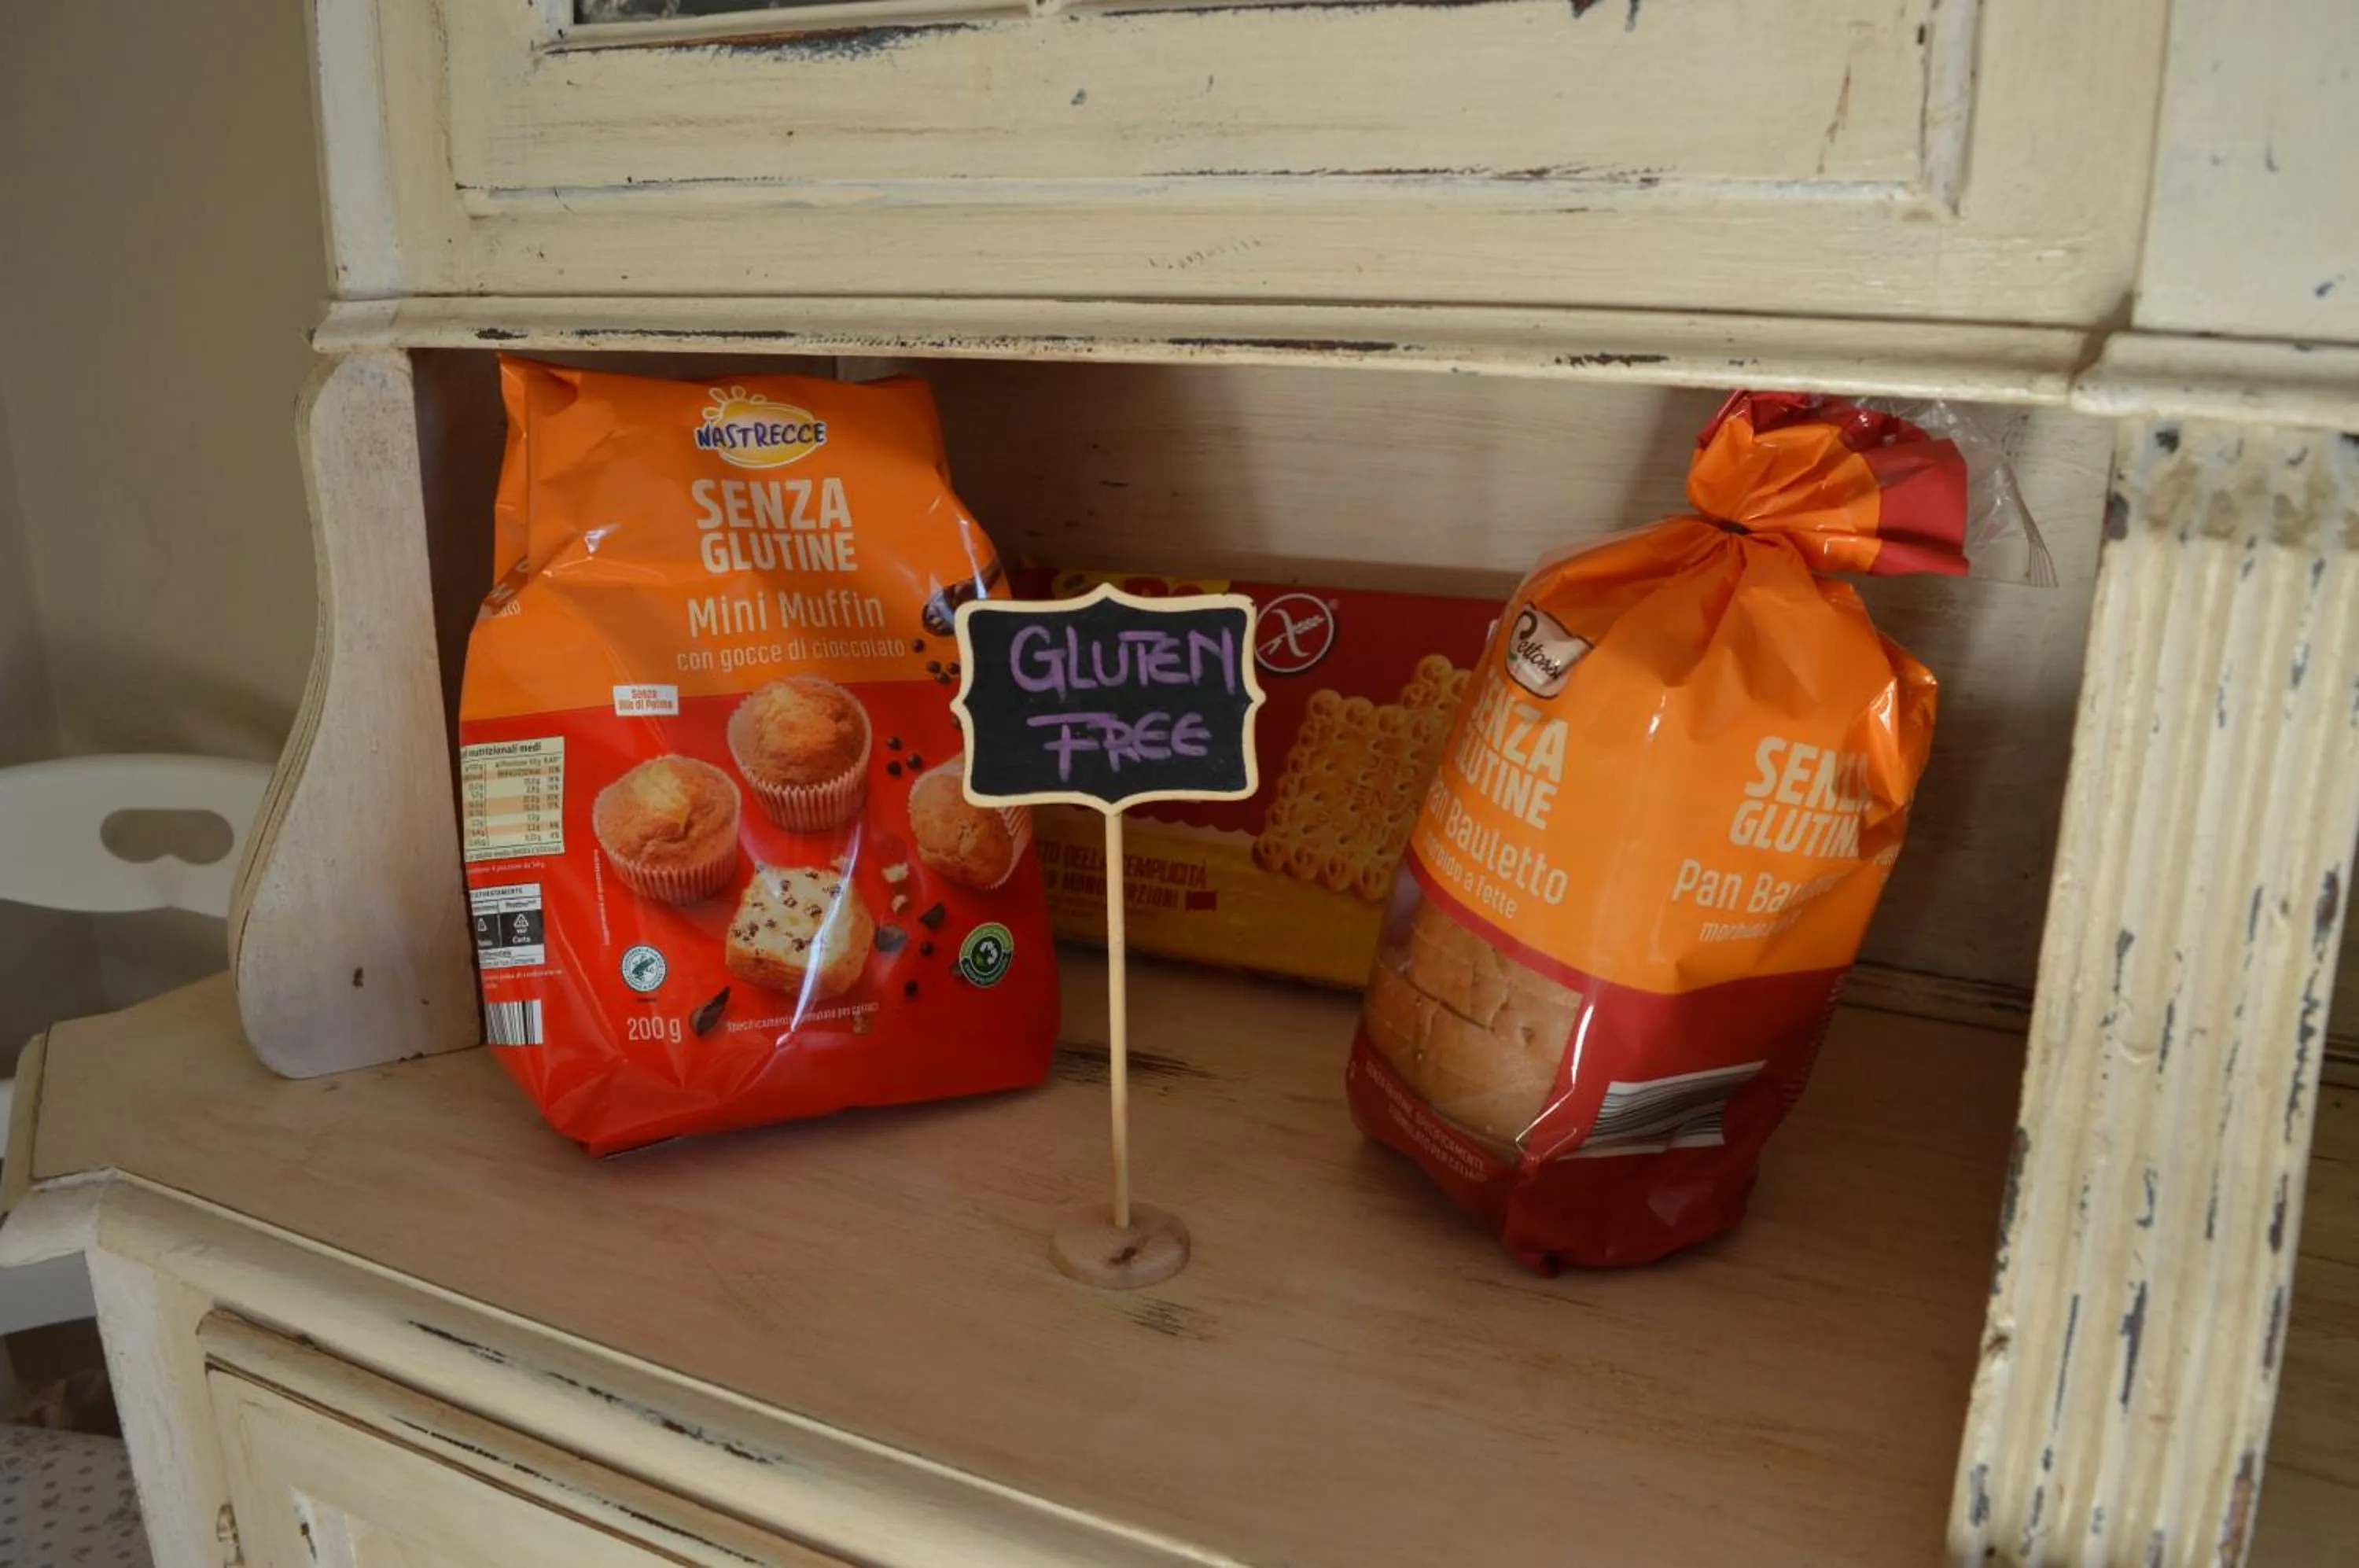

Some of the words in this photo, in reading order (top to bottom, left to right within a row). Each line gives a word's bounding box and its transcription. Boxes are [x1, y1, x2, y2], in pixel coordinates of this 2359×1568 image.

[697, 422, 826, 448] NASTRECCE
[691, 477, 853, 530] SENZA
[701, 532, 858, 574] GLUTINE
[686, 591, 767, 638] Mini
[778, 588, 885, 628] Muffin
[676, 651, 714, 671] con
[719, 643, 783, 673] gocce
[789, 636, 807, 661] di
[811, 637, 906, 659] cioccolato
[1010, 624, 1236, 701] GLUTEN
[1026, 711, 1213, 782] FREE
[1444, 797, 1568, 905] Bauletto
[1729, 799, 1859, 860] GLUTIN
[1463, 870, 1474, 893] a
[1476, 874, 1518, 919] fette
[1672, 858, 1743, 911] Pan
[627, 1017, 665, 1041] 200
[668, 1018, 682, 1044] g
